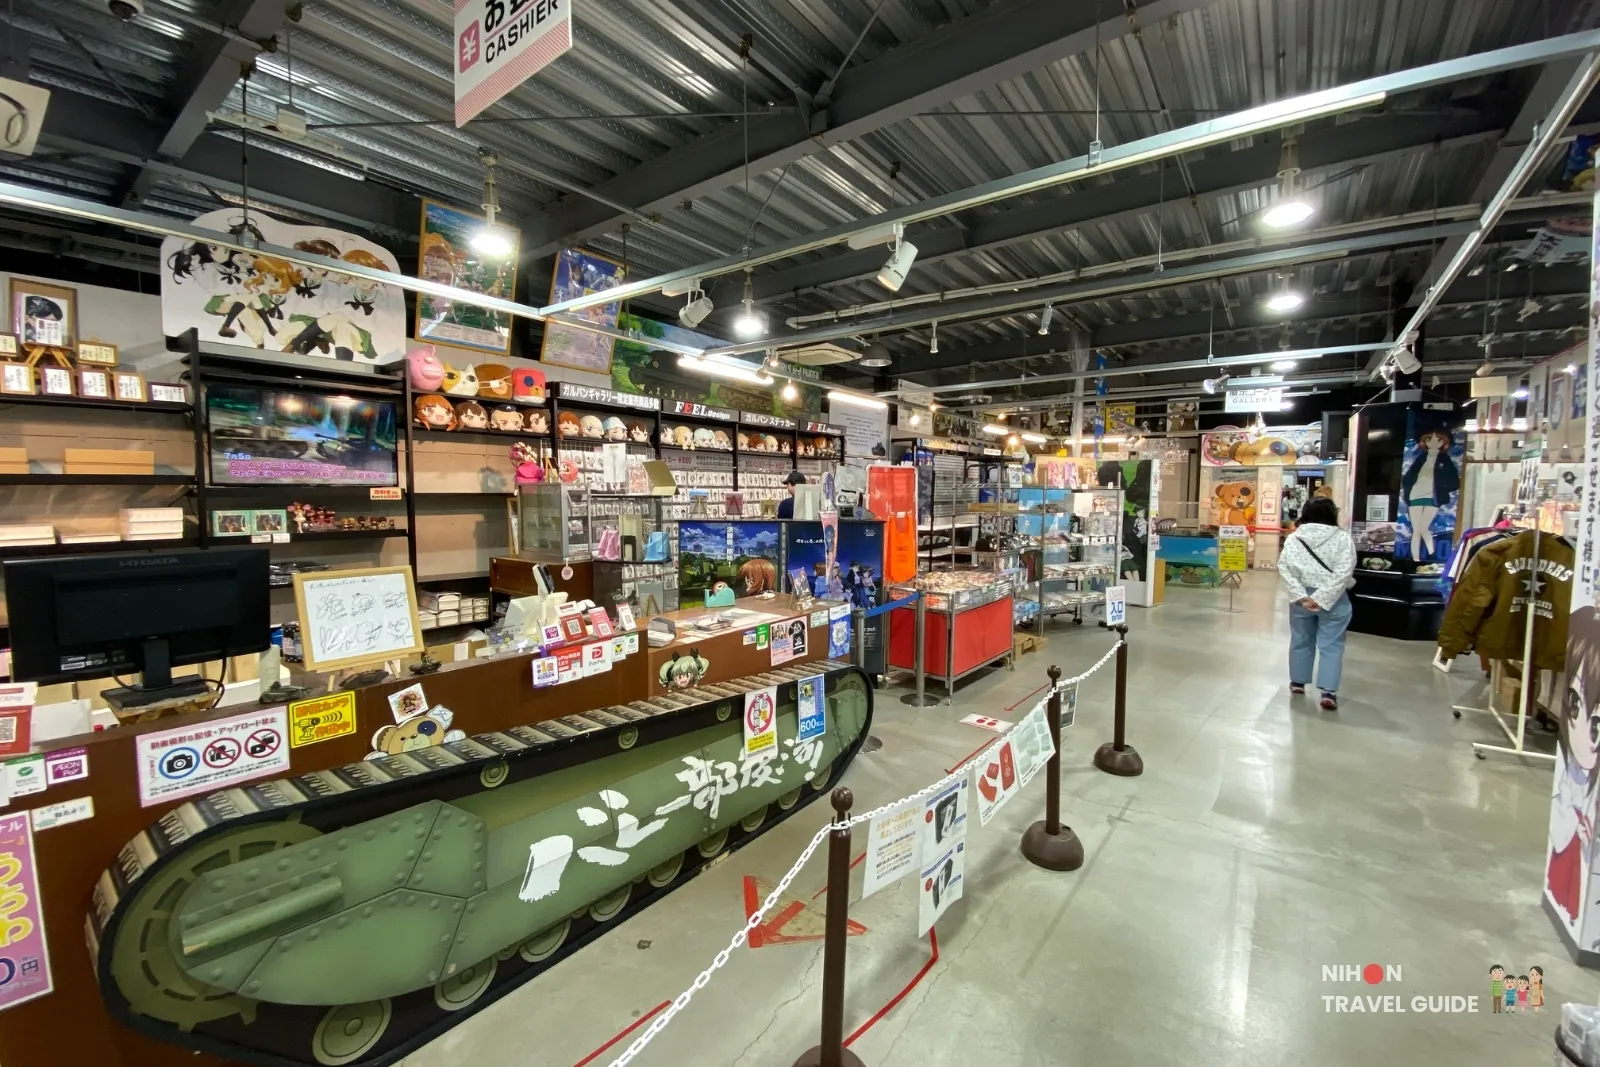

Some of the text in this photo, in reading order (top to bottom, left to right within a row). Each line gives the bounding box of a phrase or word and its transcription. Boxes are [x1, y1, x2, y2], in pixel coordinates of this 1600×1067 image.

[486, 0, 558, 63] CASHIER
[674, 401, 730, 420] FEEL Design
[745, 412, 796, 428] ガルパン ステッカー
[807, 421, 827, 433] FEEL
[224, 452, 251, 460] 7月5日
[1110, 601, 1123, 615] 入口
[588, 659, 606, 668] PayPay
[800, 718, 817, 733] 600
[63, 768, 80, 777] Pay
